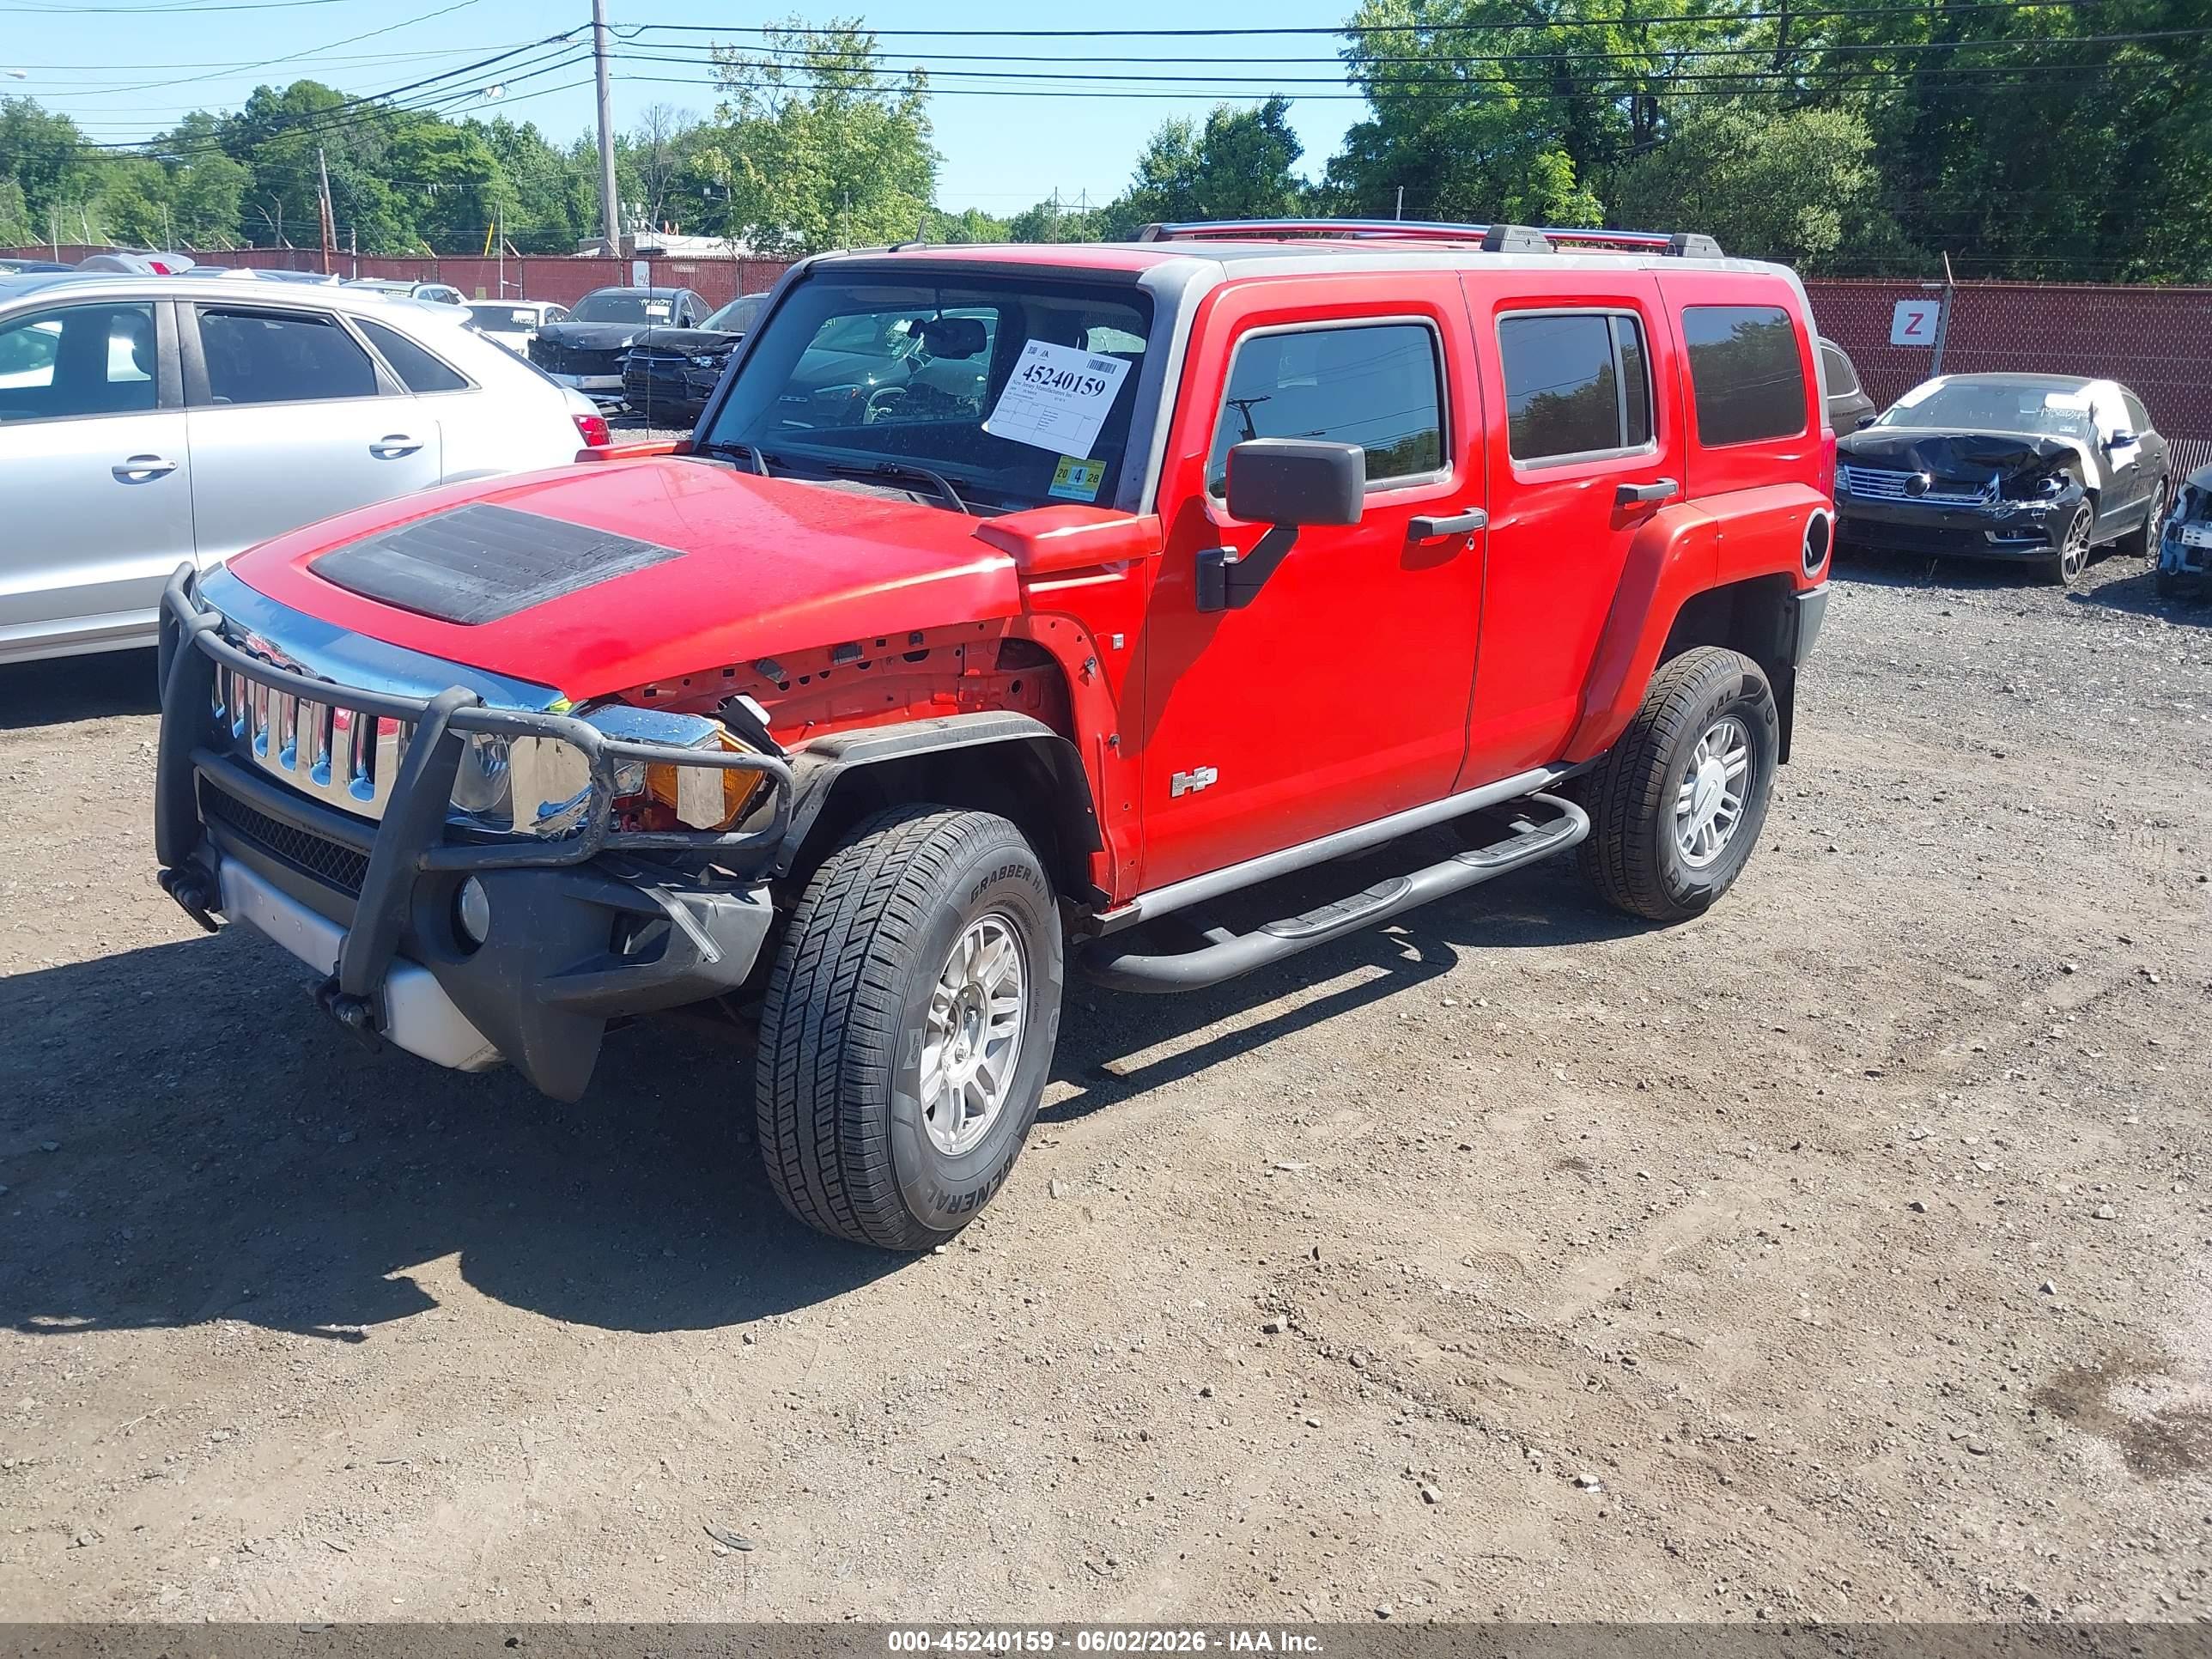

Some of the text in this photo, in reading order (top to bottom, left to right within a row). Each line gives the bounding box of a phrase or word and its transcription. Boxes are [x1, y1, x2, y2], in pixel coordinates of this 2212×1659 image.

[1905, 313, 1923, 335] Z
[1023, 364, 1106, 398] 45240159
[1057, 468, 1099, 483] 20 4 28
[969, 864, 1033, 904] GRABBER
[927, 1153, 1013, 1214] GENERAL
